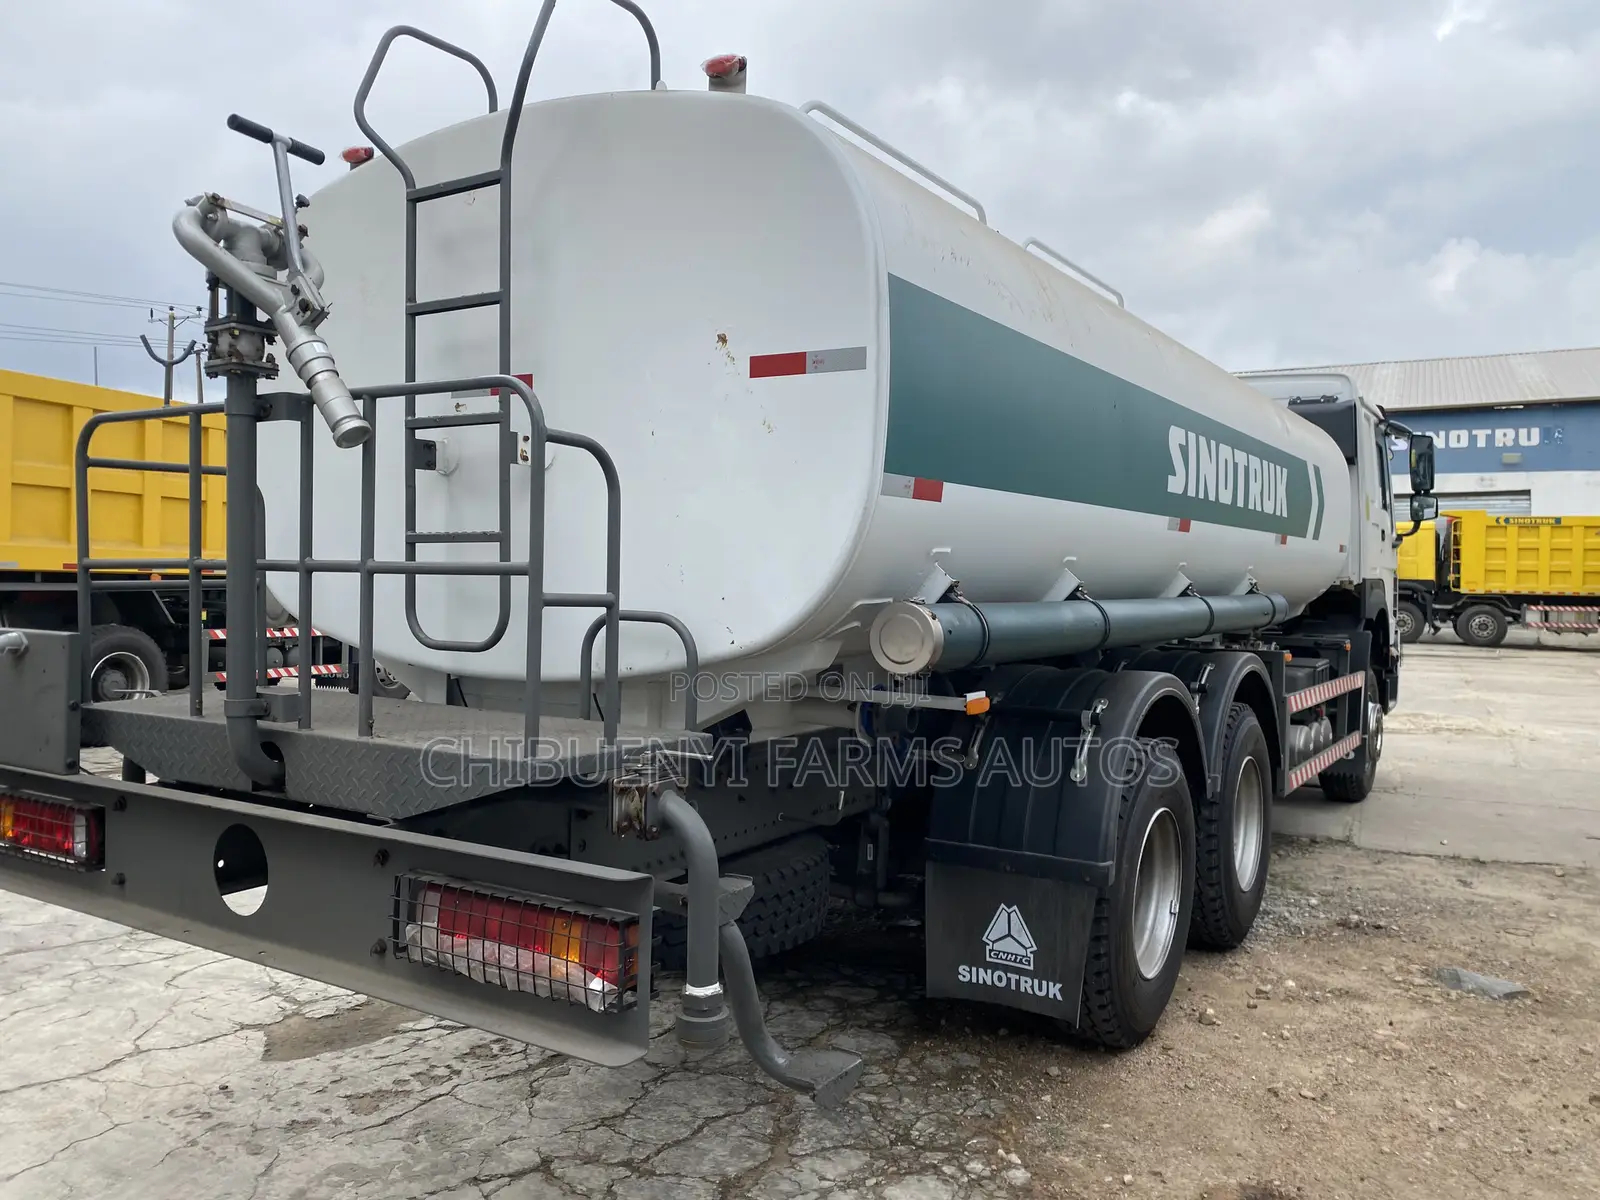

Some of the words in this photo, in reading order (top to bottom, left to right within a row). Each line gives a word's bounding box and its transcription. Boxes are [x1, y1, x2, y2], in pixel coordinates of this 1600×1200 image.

[1390, 427, 1563, 451] SNOTRU
[1167, 425, 1288, 518] SINOTRUK
[989, 950, 1031, 965] CNHTC
[957, 964, 1064, 1001] SINOTRUK
